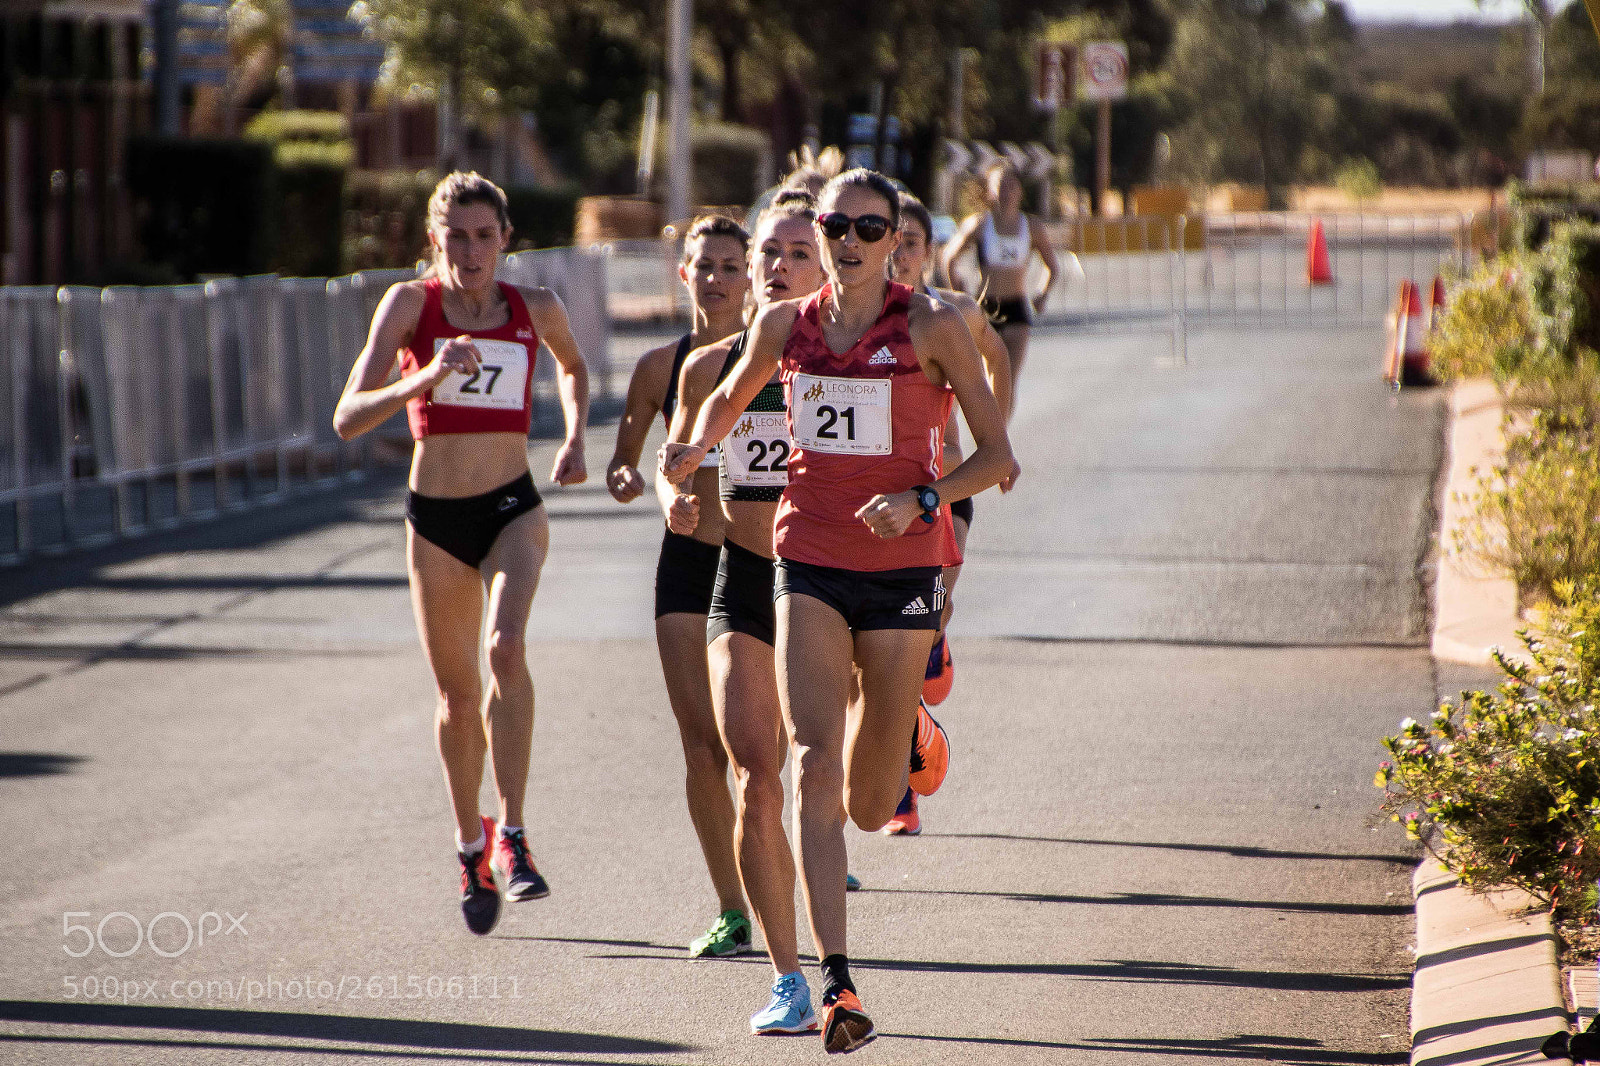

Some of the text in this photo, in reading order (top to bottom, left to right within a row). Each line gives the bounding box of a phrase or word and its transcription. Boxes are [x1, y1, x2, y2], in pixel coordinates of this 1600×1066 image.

[868, 357, 898, 365] adidas
[460, 365, 503, 394] 27
[826, 383, 878, 395] LEONORA
[755, 417, 788, 427] LEONO
[816, 404, 856, 441] 21
[746, 439, 790, 472] 22
